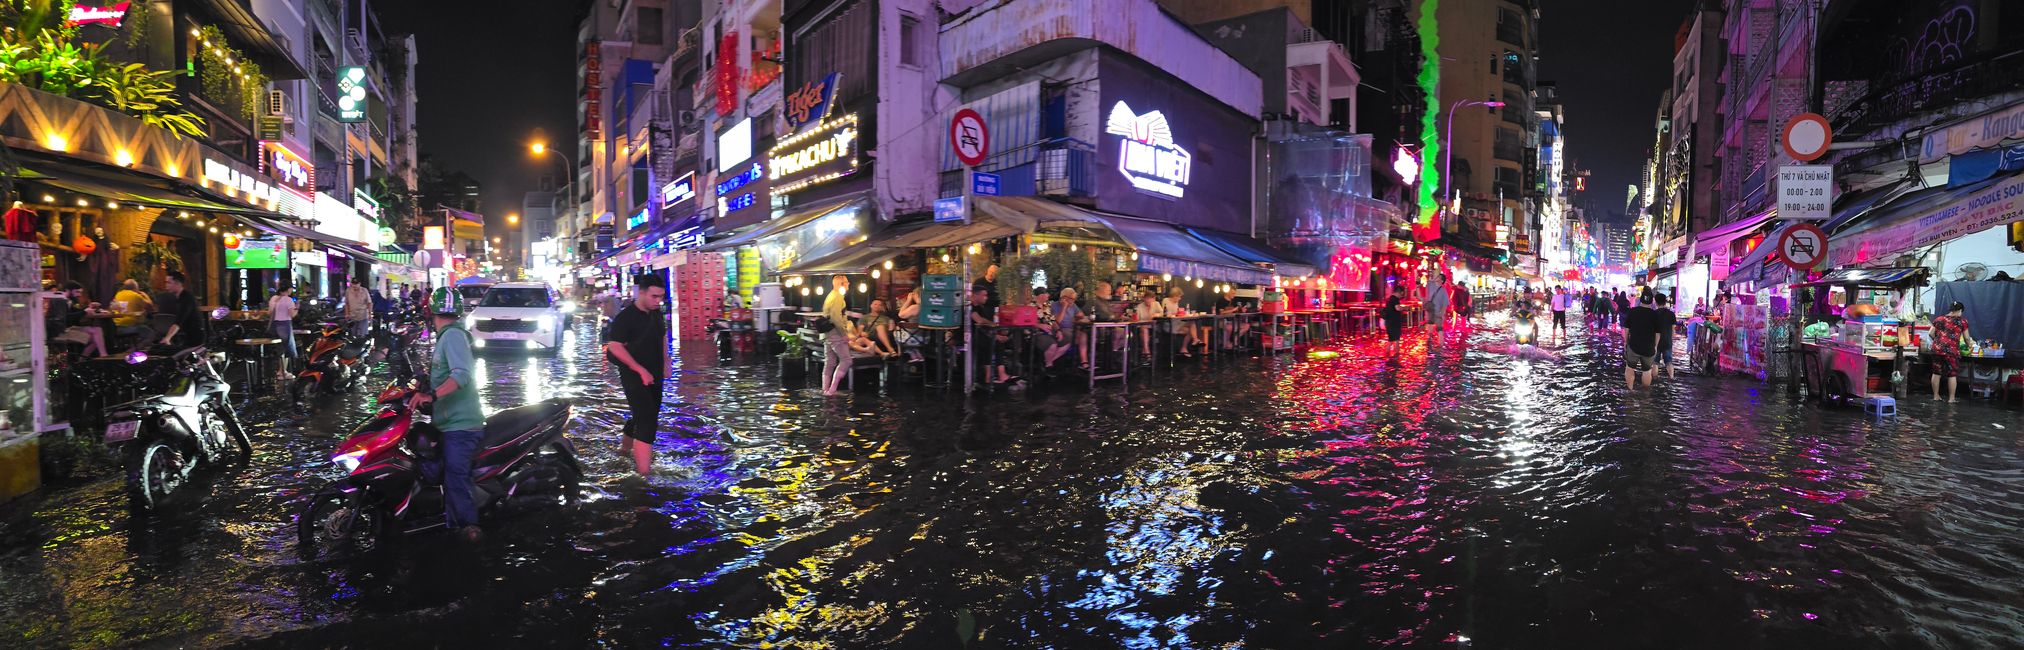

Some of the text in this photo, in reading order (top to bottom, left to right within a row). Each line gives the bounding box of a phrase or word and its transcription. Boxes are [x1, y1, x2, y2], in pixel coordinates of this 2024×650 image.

[587, 43, 599, 131] HOSTEL
[788, 81, 825, 122] Tiger
[1784, 203, 1801, 211] 19:00
[1807, 203, 1825, 211] 24:00
[1786, 188, 1804, 196] 00:00
[1810, 188, 1823, 196] 2:00
[1919, 206, 1960, 227] VIETNAMESE
[1968, 191, 2001, 211] NOODLE
